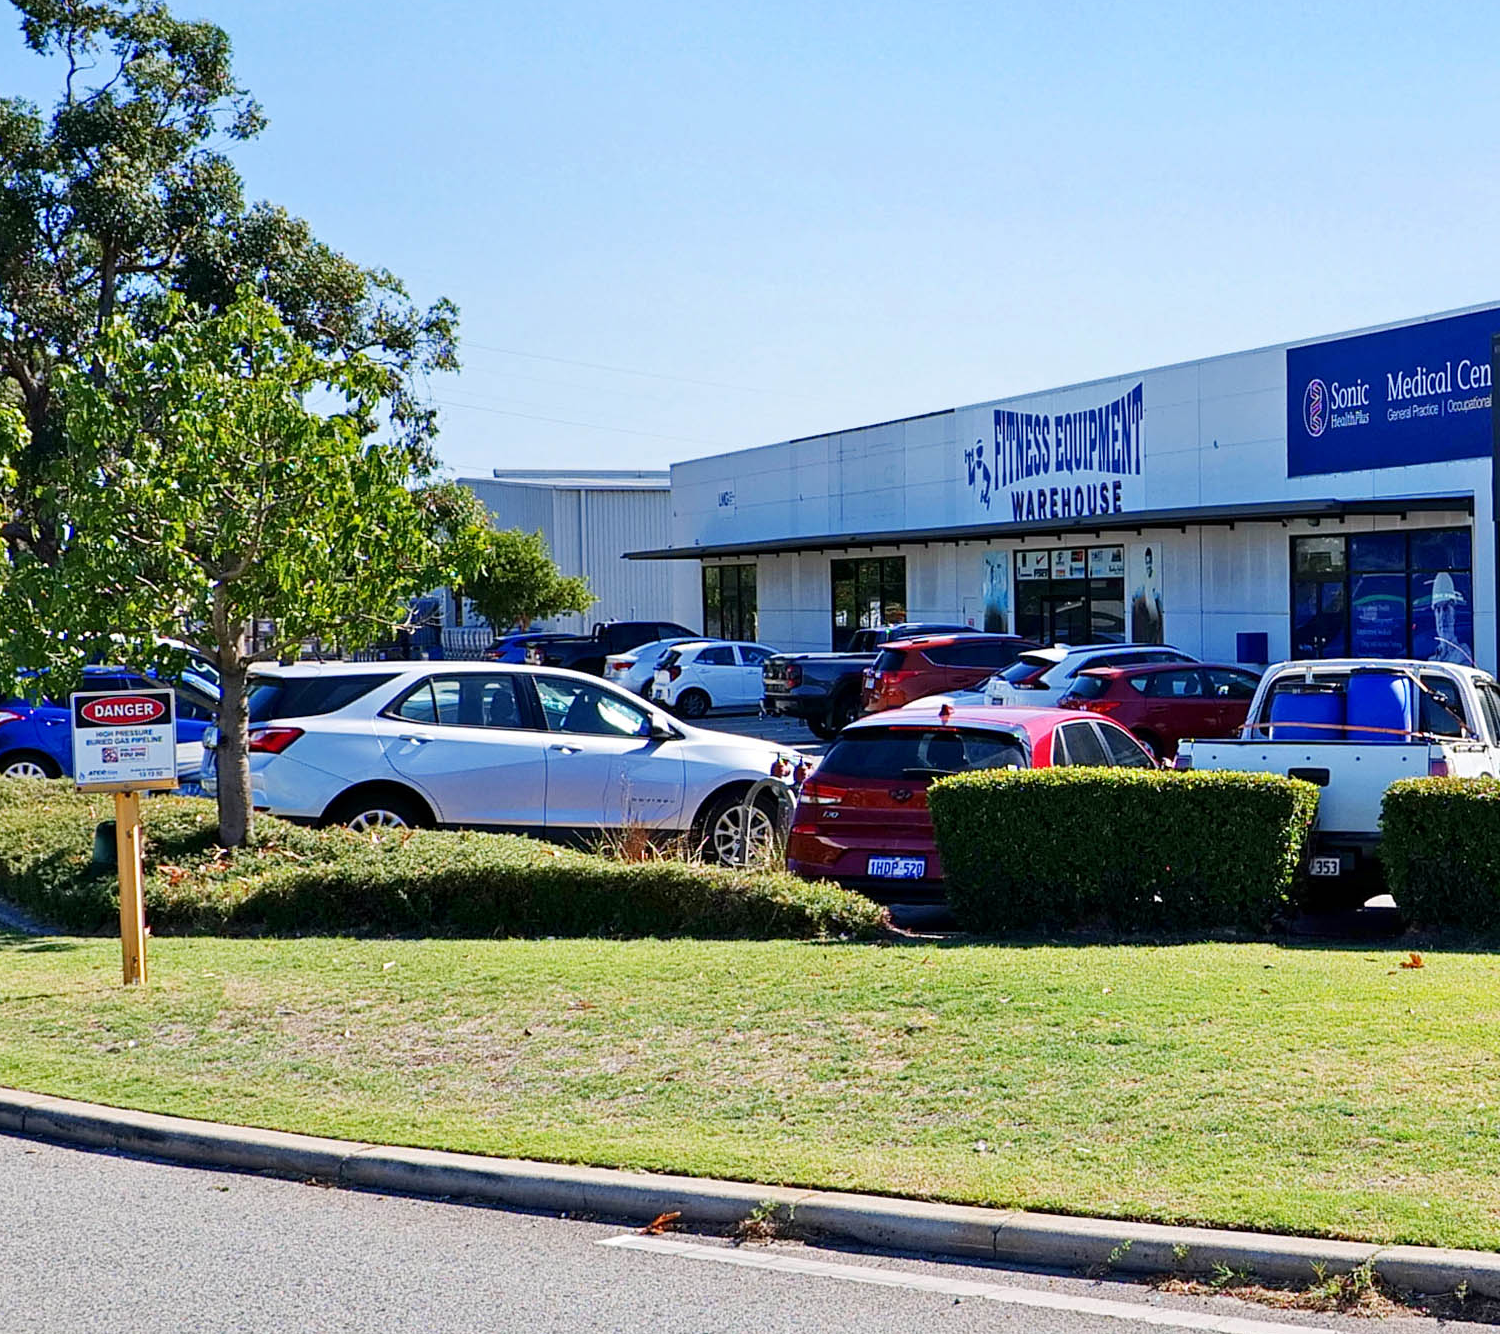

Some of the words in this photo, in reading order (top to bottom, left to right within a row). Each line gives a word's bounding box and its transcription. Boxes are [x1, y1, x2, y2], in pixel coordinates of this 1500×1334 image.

[1331, 379, 1369, 410] Sonic
[1386, 361, 1452, 401] Medical
[1331, 409, 1369, 429] HealthPlus
[1387, 406, 1412, 422] General
[1412, 403, 1439, 418] Practice
[993, 409, 1050, 491] FITNESS
[1054, 381, 1143, 476] EQUIPMENT
[1011, 480, 1122, 523] WAREHOUSE
[94, 703, 154, 717] DANGER
